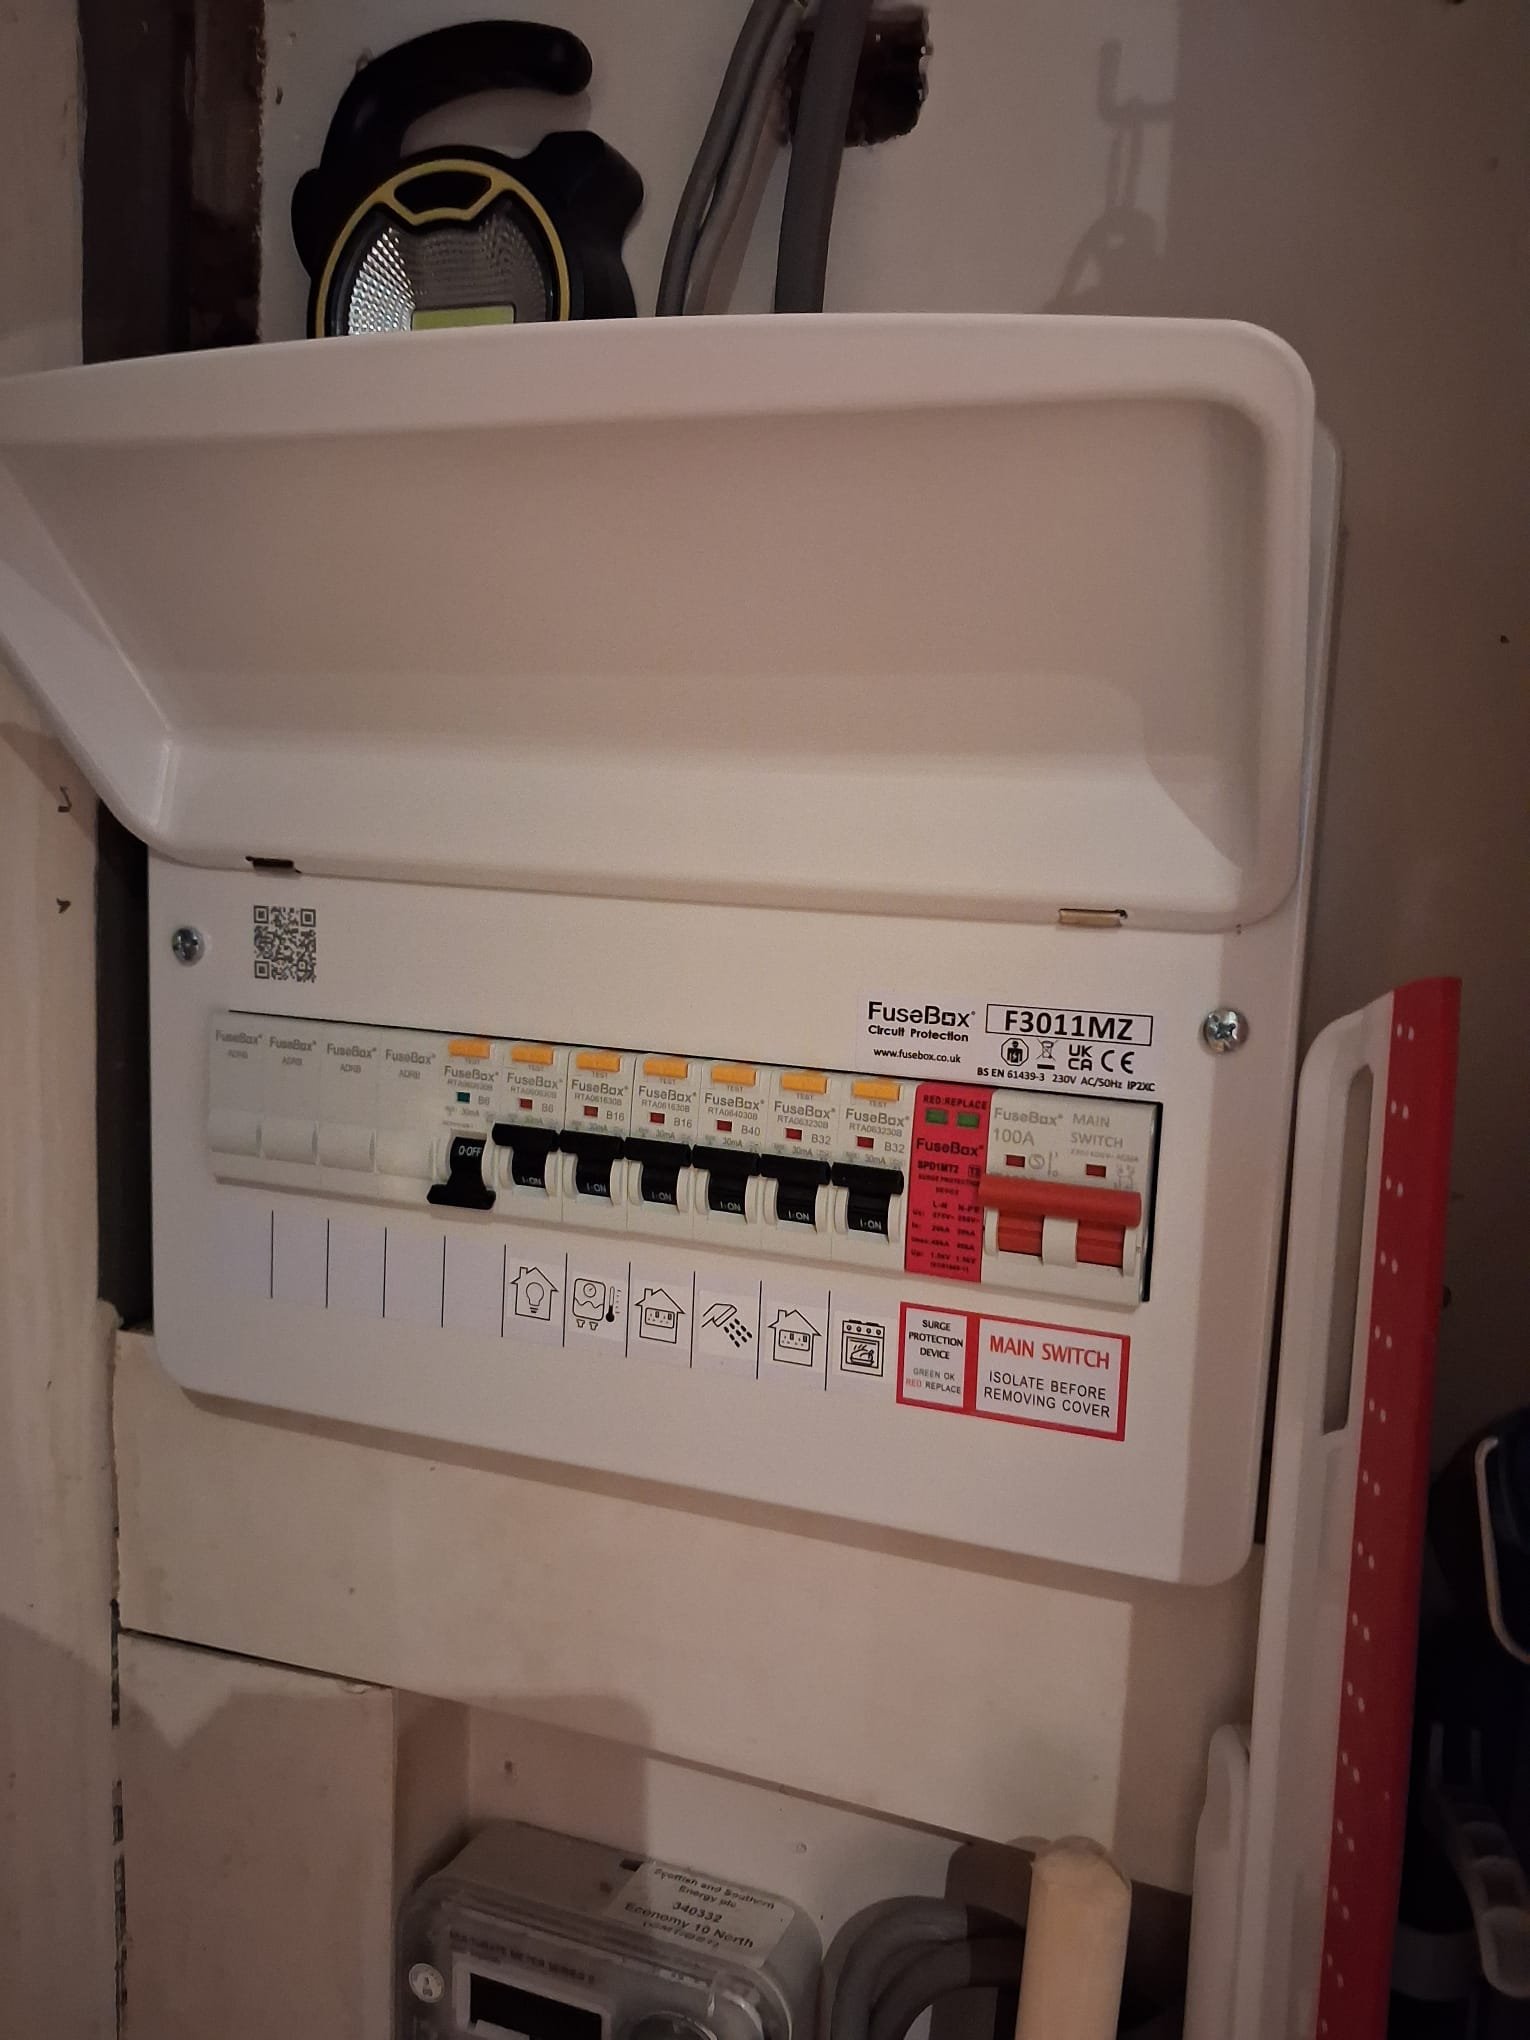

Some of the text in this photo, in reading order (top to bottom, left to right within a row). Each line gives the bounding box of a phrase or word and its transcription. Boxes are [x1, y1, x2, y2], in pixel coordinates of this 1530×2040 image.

[868, 1024, 969, 1042] Circuit Protection
[1004, 1010, 1134, 1041] F3011MZ
[873, 1048, 961, 1063] www.fusebox.co.uk
[1068, 1044, 1093, 1058] UK
[1068, 1058, 1093, 1072] CA
[977, 1067, 1156, 1092] BS EN 61439-3 230V AC/50Hz IP2XC
[606, 1111, 625, 1121] B16
[673, 1117, 693, 1128] B16
[1072, 1113, 1110, 1128] MAIN
[741, 1125, 760, 1136] B40
[993, 1128, 1035, 1146] 100A
[811, 1134, 831, 1145] B32
[884, 1141, 905, 1154] B32
[1070, 1132, 1124, 1149] SWITCH
[922, 1319, 951, 1331] SURGE
[908, 1331, 963, 1348] PROTECTION
[920, 1347, 950, 1360] DEVICE
[990, 1335, 1110, 1370] MAIN SWITCH
[913, 1367, 955, 1382] GREEN OK
[905, 1377, 961, 1395] RED REPLACE
[989, 1371, 1106, 1401] ISOLATE BEFORE
[984, 1386, 1111, 1418] REMOVING COVER
[678, 1885, 718, 1904] Energy
[700, 1882, 722, 1893] and
[672, 1902, 723, 1924] 340332
[624, 1903, 690, 1929] Economy
[695, 1923, 710, 1935] 10
[714, 1928, 754, 1949] North
